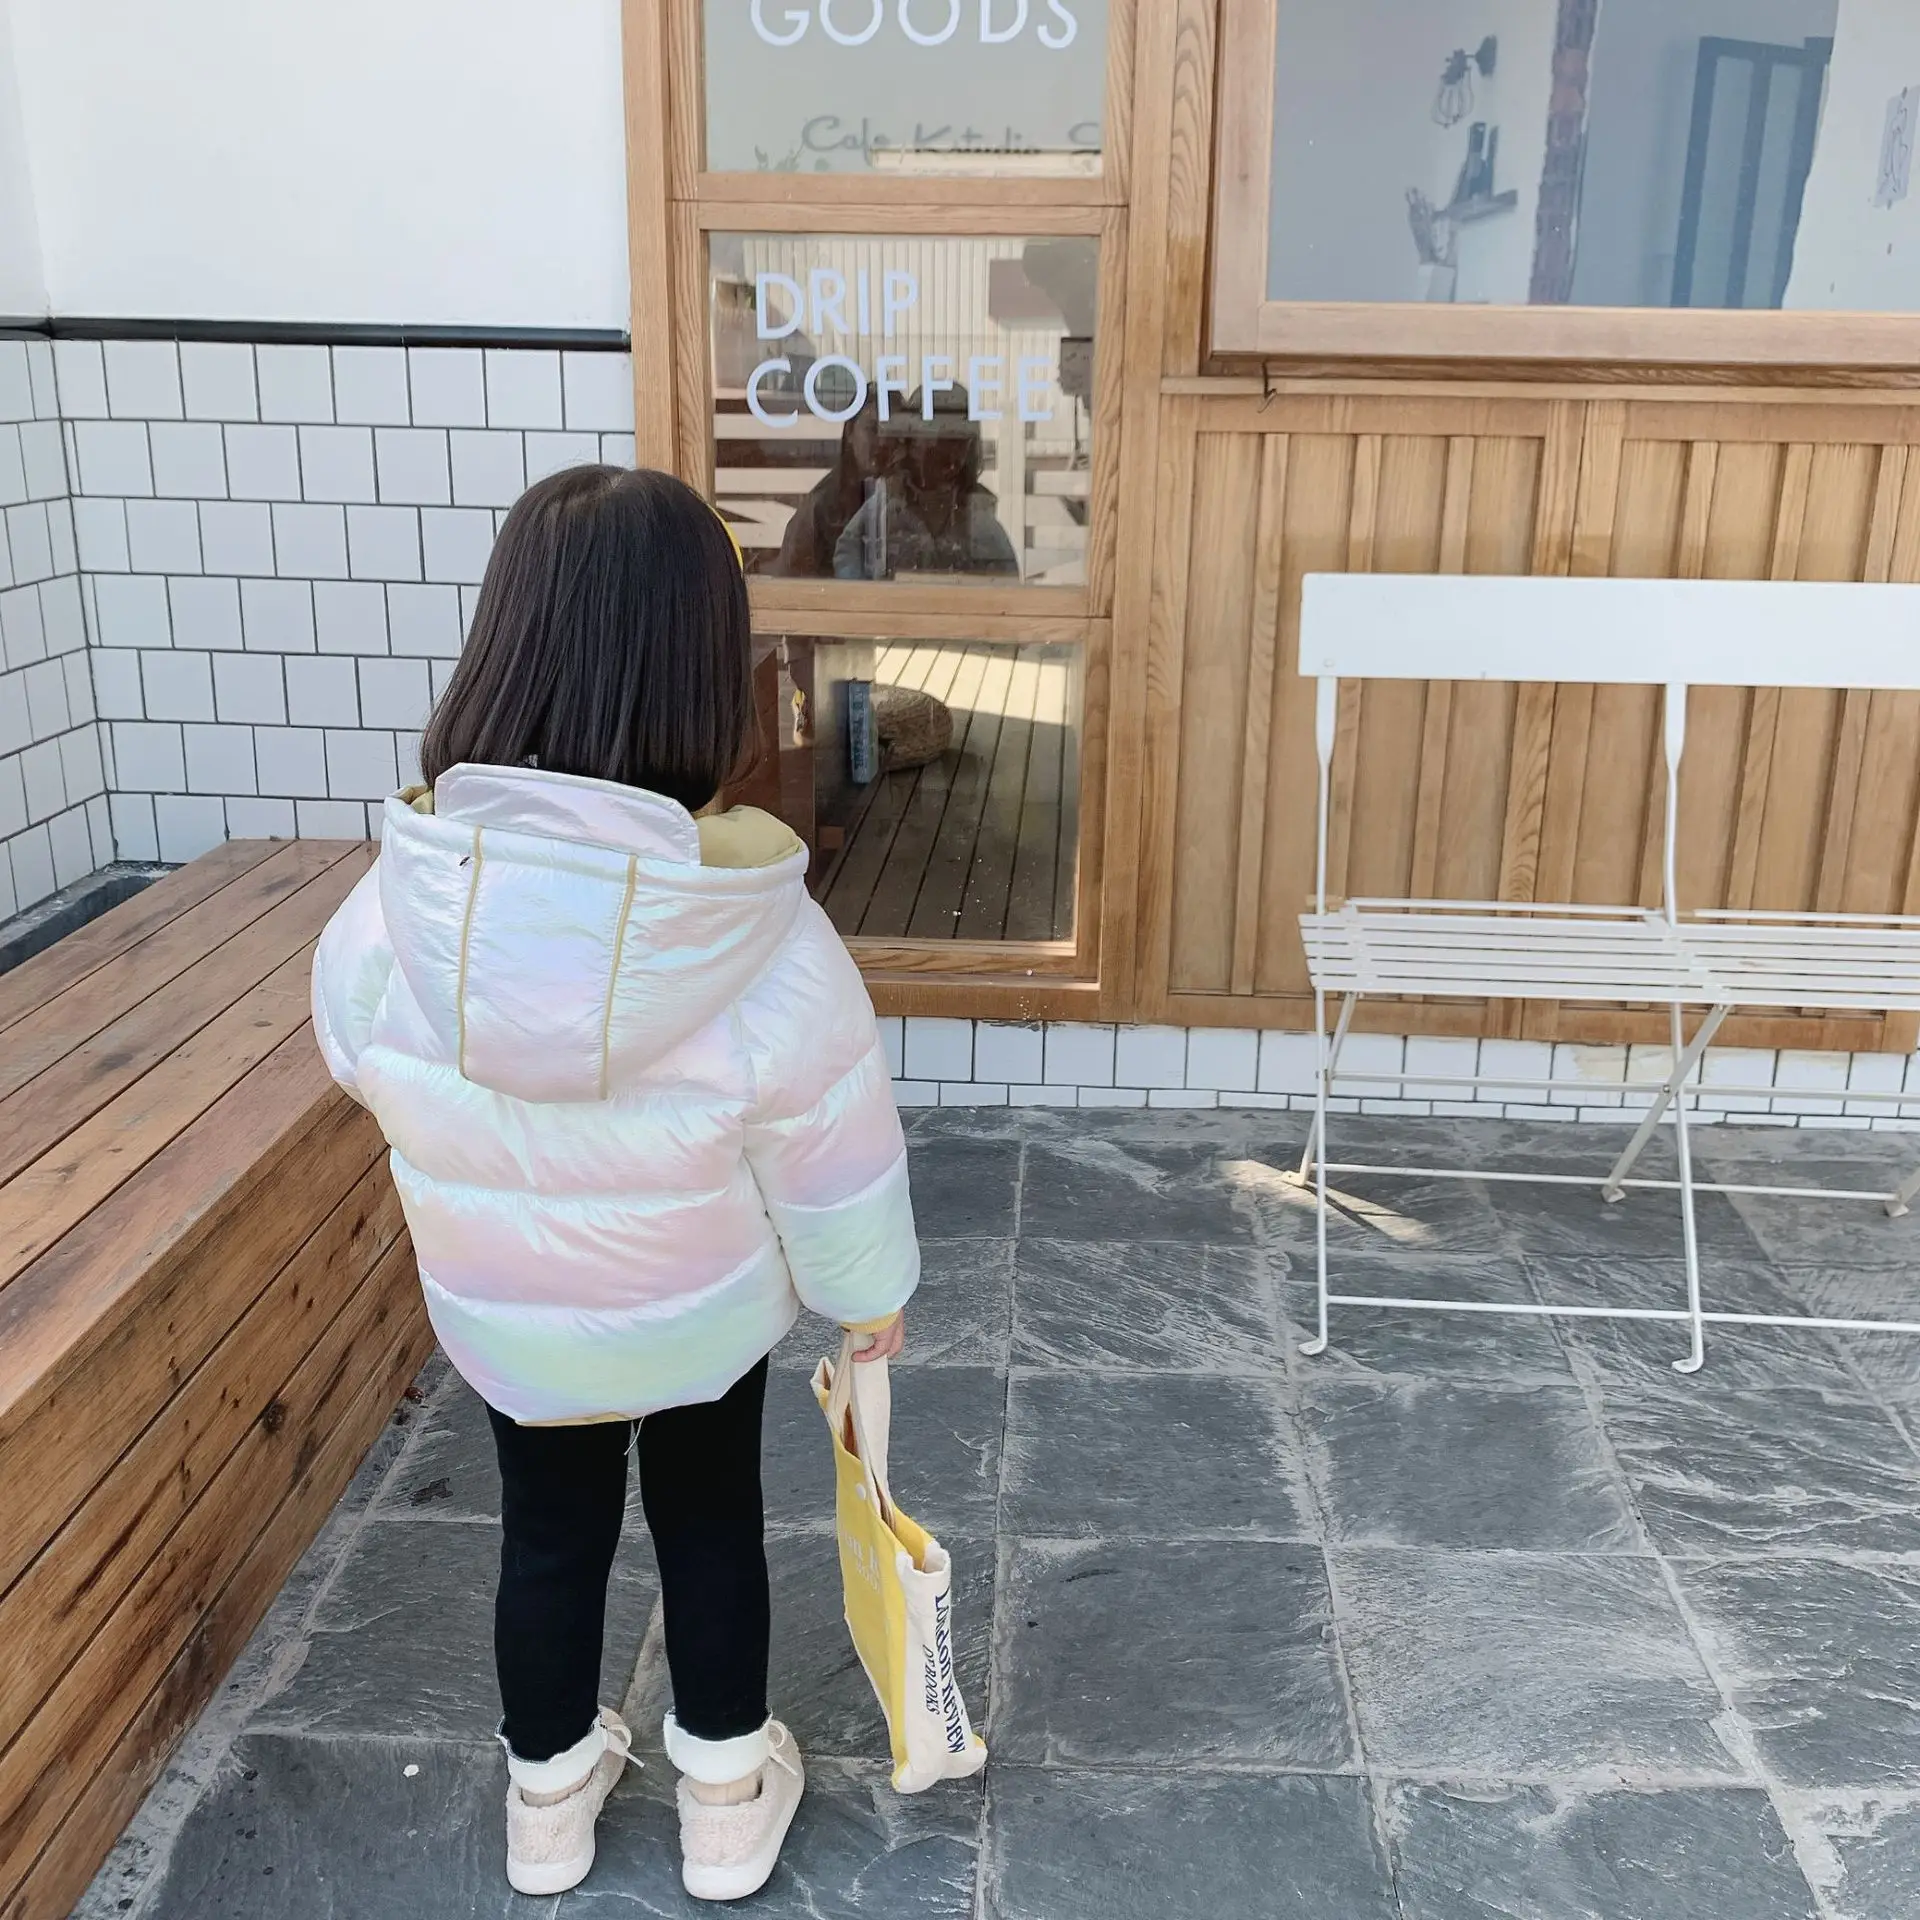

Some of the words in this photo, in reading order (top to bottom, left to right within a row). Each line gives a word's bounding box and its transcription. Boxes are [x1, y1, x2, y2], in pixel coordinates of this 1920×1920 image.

[750, 0, 1077, 49] GOODS
[755, 267, 919, 340] DRIP
[746, 355, 1054, 428] COFFEE
[935, 1585, 951, 1681] London
[924, 1663, 941, 1716] BOOKS
